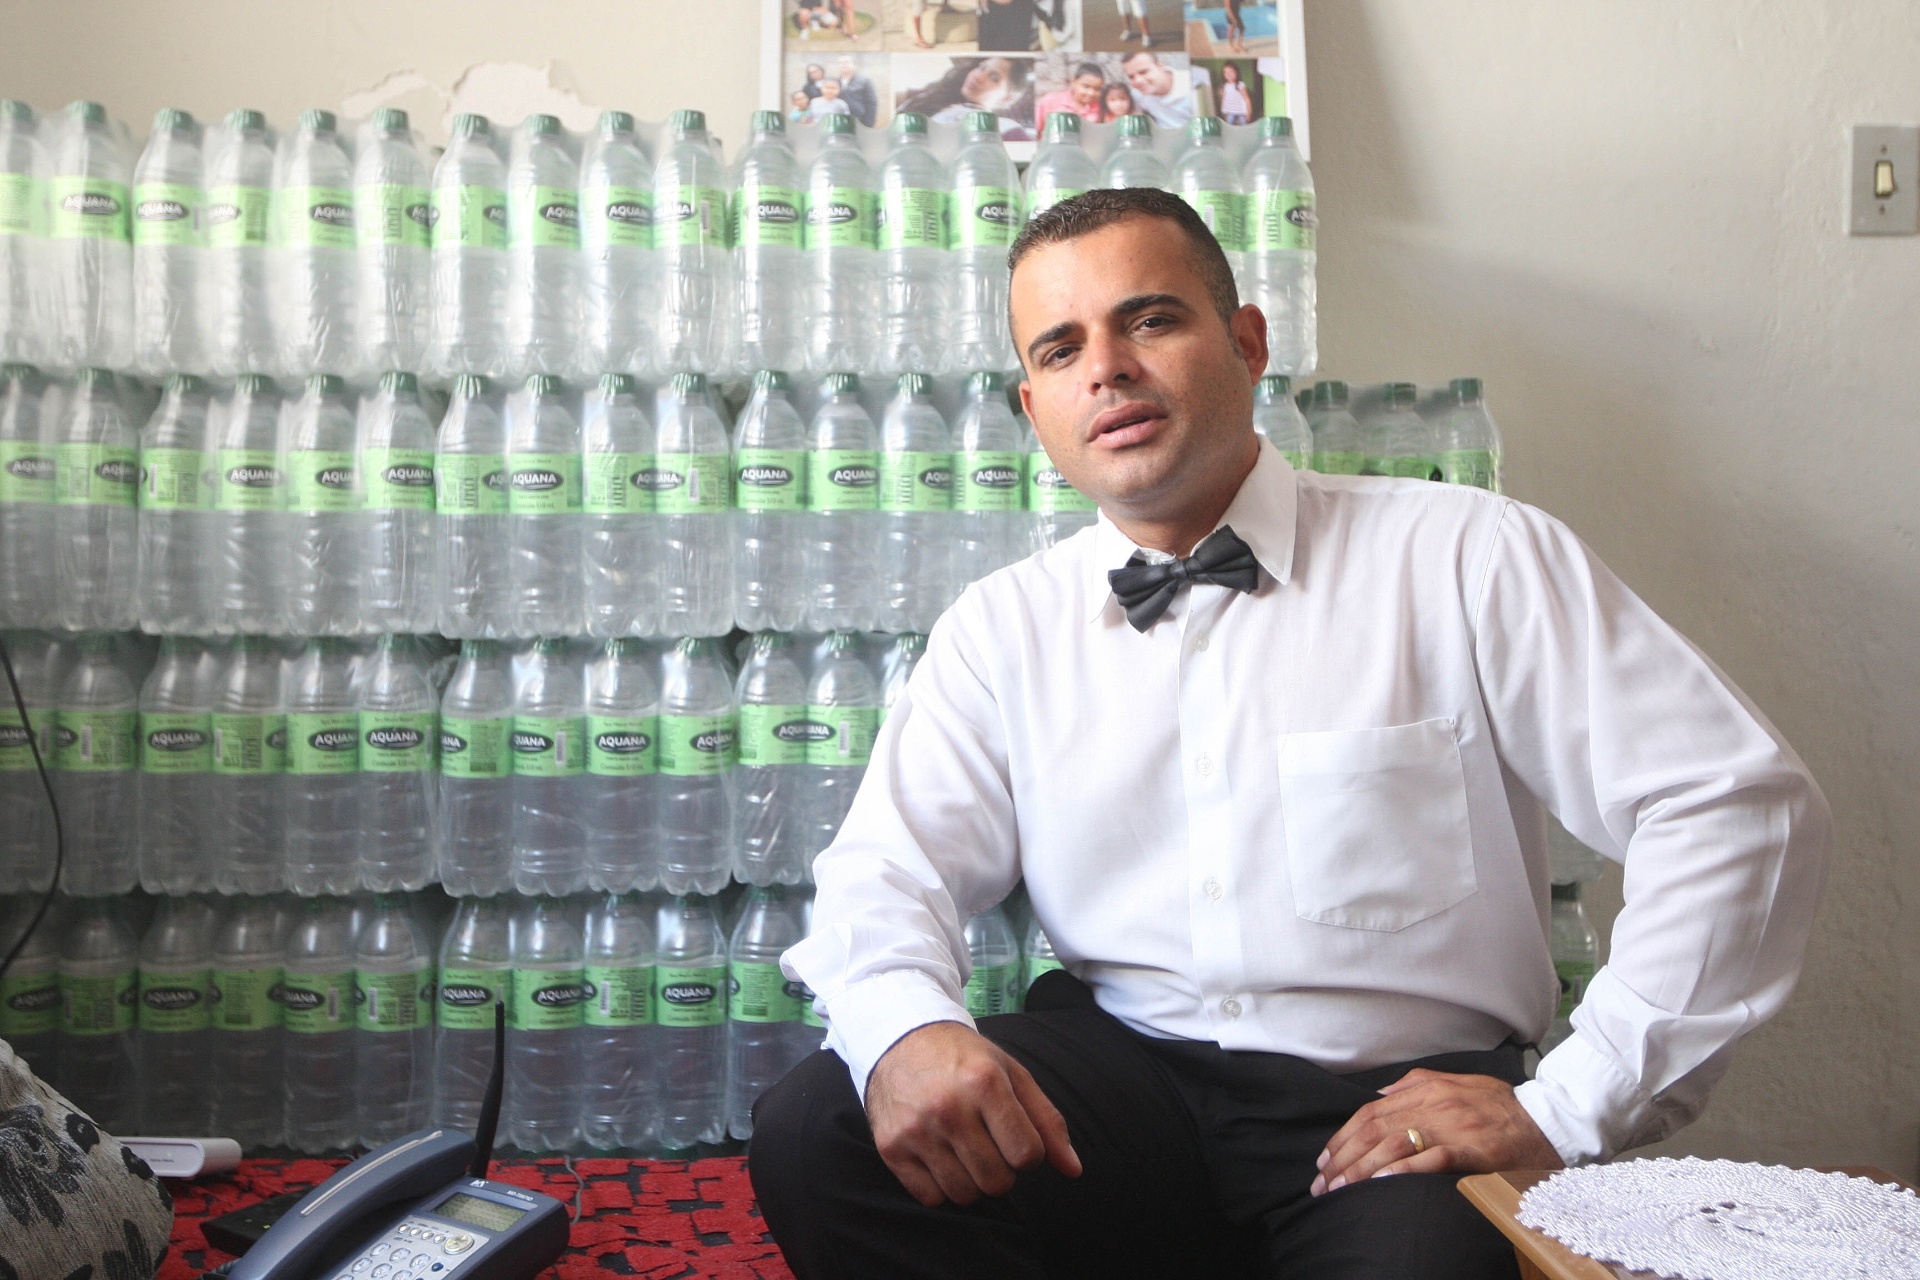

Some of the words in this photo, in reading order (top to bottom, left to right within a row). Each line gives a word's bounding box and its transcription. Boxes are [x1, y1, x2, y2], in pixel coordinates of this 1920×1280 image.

[512, 473, 557, 485] AQUANA
[741, 469, 788, 481] AQUANA
[152, 732, 201, 745] AQUANA
[370, 732, 418, 744] AQUANA
[599, 735, 646, 748] AQUANA
[666, 987, 711, 1000] AQUANA
